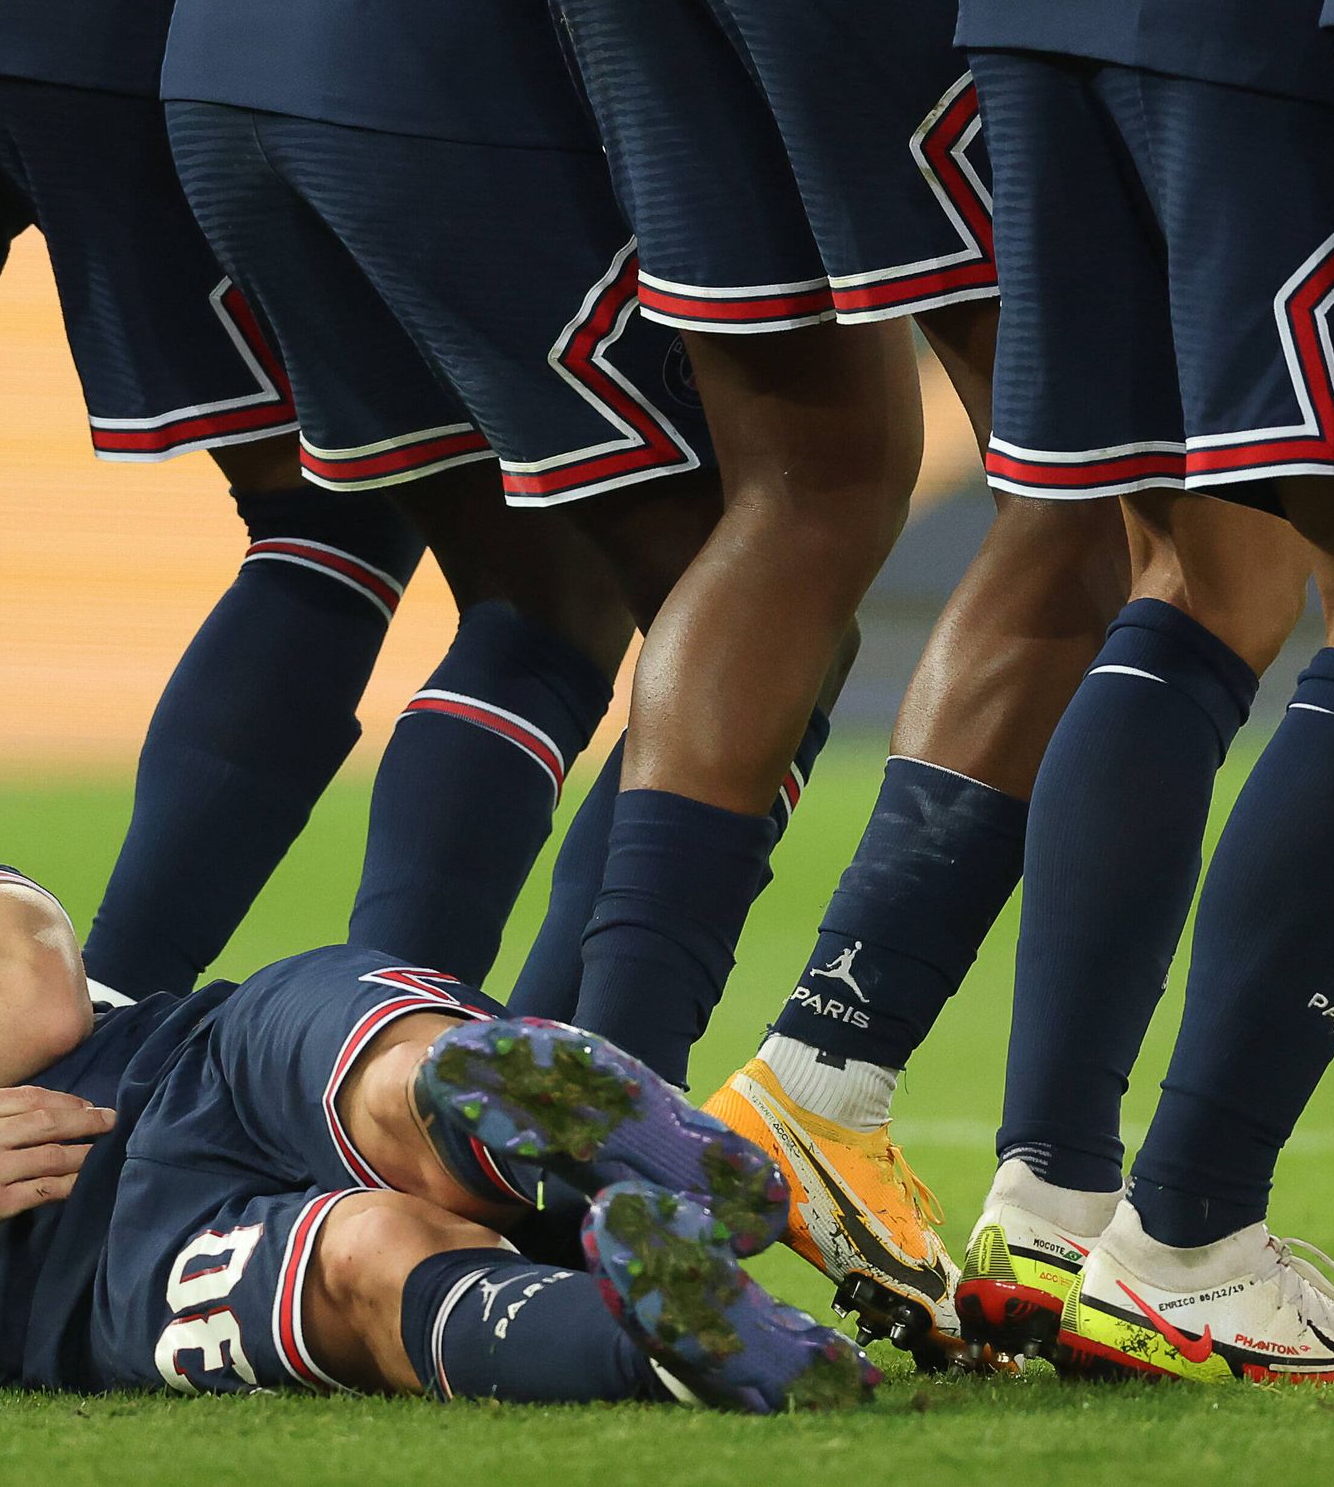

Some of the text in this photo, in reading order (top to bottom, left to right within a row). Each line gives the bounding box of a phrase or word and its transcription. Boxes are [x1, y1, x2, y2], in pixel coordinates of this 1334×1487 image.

[782, 986, 870, 1029] PARIS
[1033, 1238, 1066, 1255] MOCOTE
[154, 1222, 264, 1396] 30
[1158, 1296, 1196, 1313] ENRICO
[1234, 1333, 1300, 1356] PHANTOM
